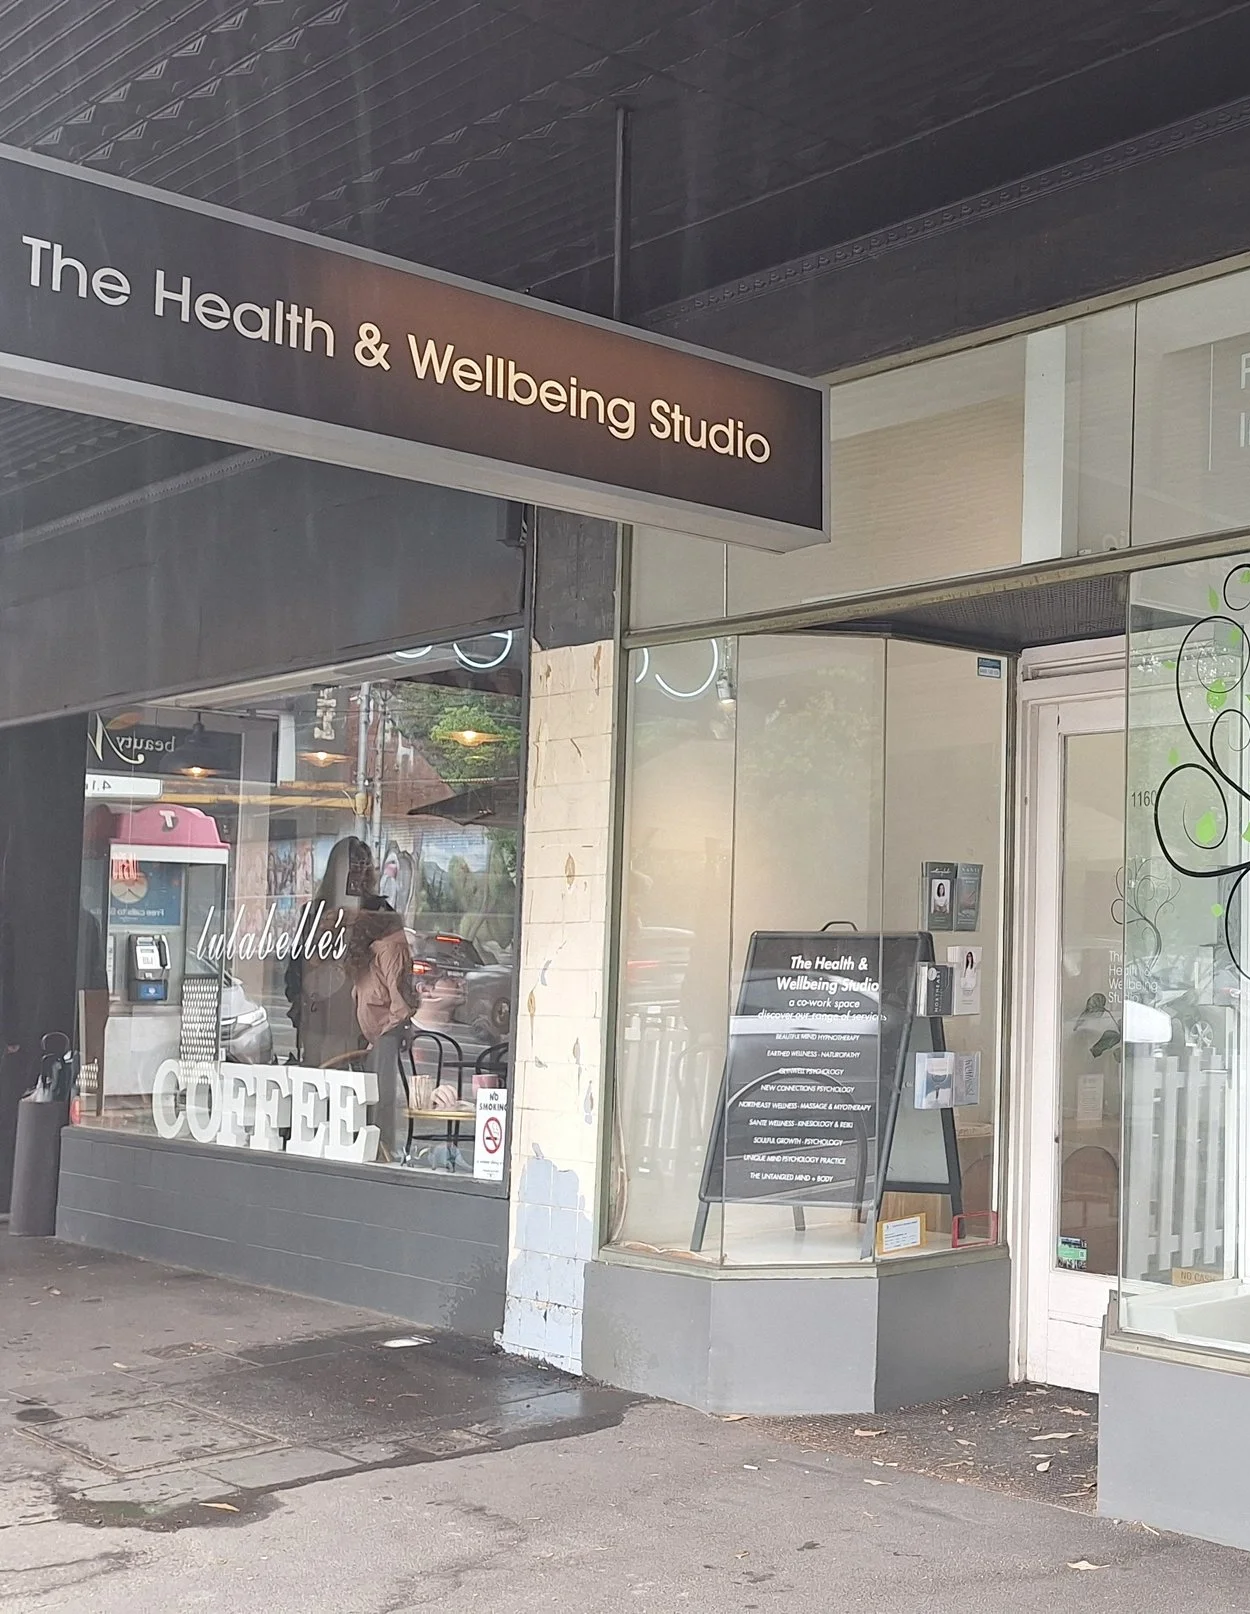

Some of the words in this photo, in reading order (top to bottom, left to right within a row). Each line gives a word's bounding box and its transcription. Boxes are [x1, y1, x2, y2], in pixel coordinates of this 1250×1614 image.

[22, 236, 131, 306] The
[154, 270, 336, 357] Health
[354, 322, 392, 372] &
[407, 333, 637, 440] Wellbeing
[650, 399, 772, 464] Studio
[196, 900, 347, 961] lulabelle's
[790, 955, 812, 970] The
[815, 956, 855, 971] Health
[858, 957, 869, 971] &
[776, 976, 838, 995] Wellbeing
[841, 977, 880, 992] Studio
[788, 999, 795, 1007] a
[796, 998, 832, 1008] co-work
[834, 1000, 860, 1011] space
[757, 1008, 794, 1020] discover
[791, 1050, 817, 1058] WELLNESS
[760, 1084, 775, 1092] NEW
[777, 1084, 816, 1093] CONNECTIONS
[816, 1085, 856, 1094] PSYCHOLOGY
[152, 1058, 380, 1164] COFFEE
[738, 1101, 772, 1110] NORTHEAST
[772, 1101, 797, 1110] WELLNESS
[800, 1102, 827, 1111] MASSAGE
[833, 1103, 872, 1112] MYOTHERAPY
[768, 1119, 794, 1128] WELLNESS
[776, 1136, 802, 1146] GROWTH
[766, 1155, 782, 1163] MIND
[750, 1171, 761, 1180] THE
[761, 1172, 794, 1181] UNTANGLED
[794, 1173, 811, 1182] MIND
[816, 1175, 834, 1183] BODY
